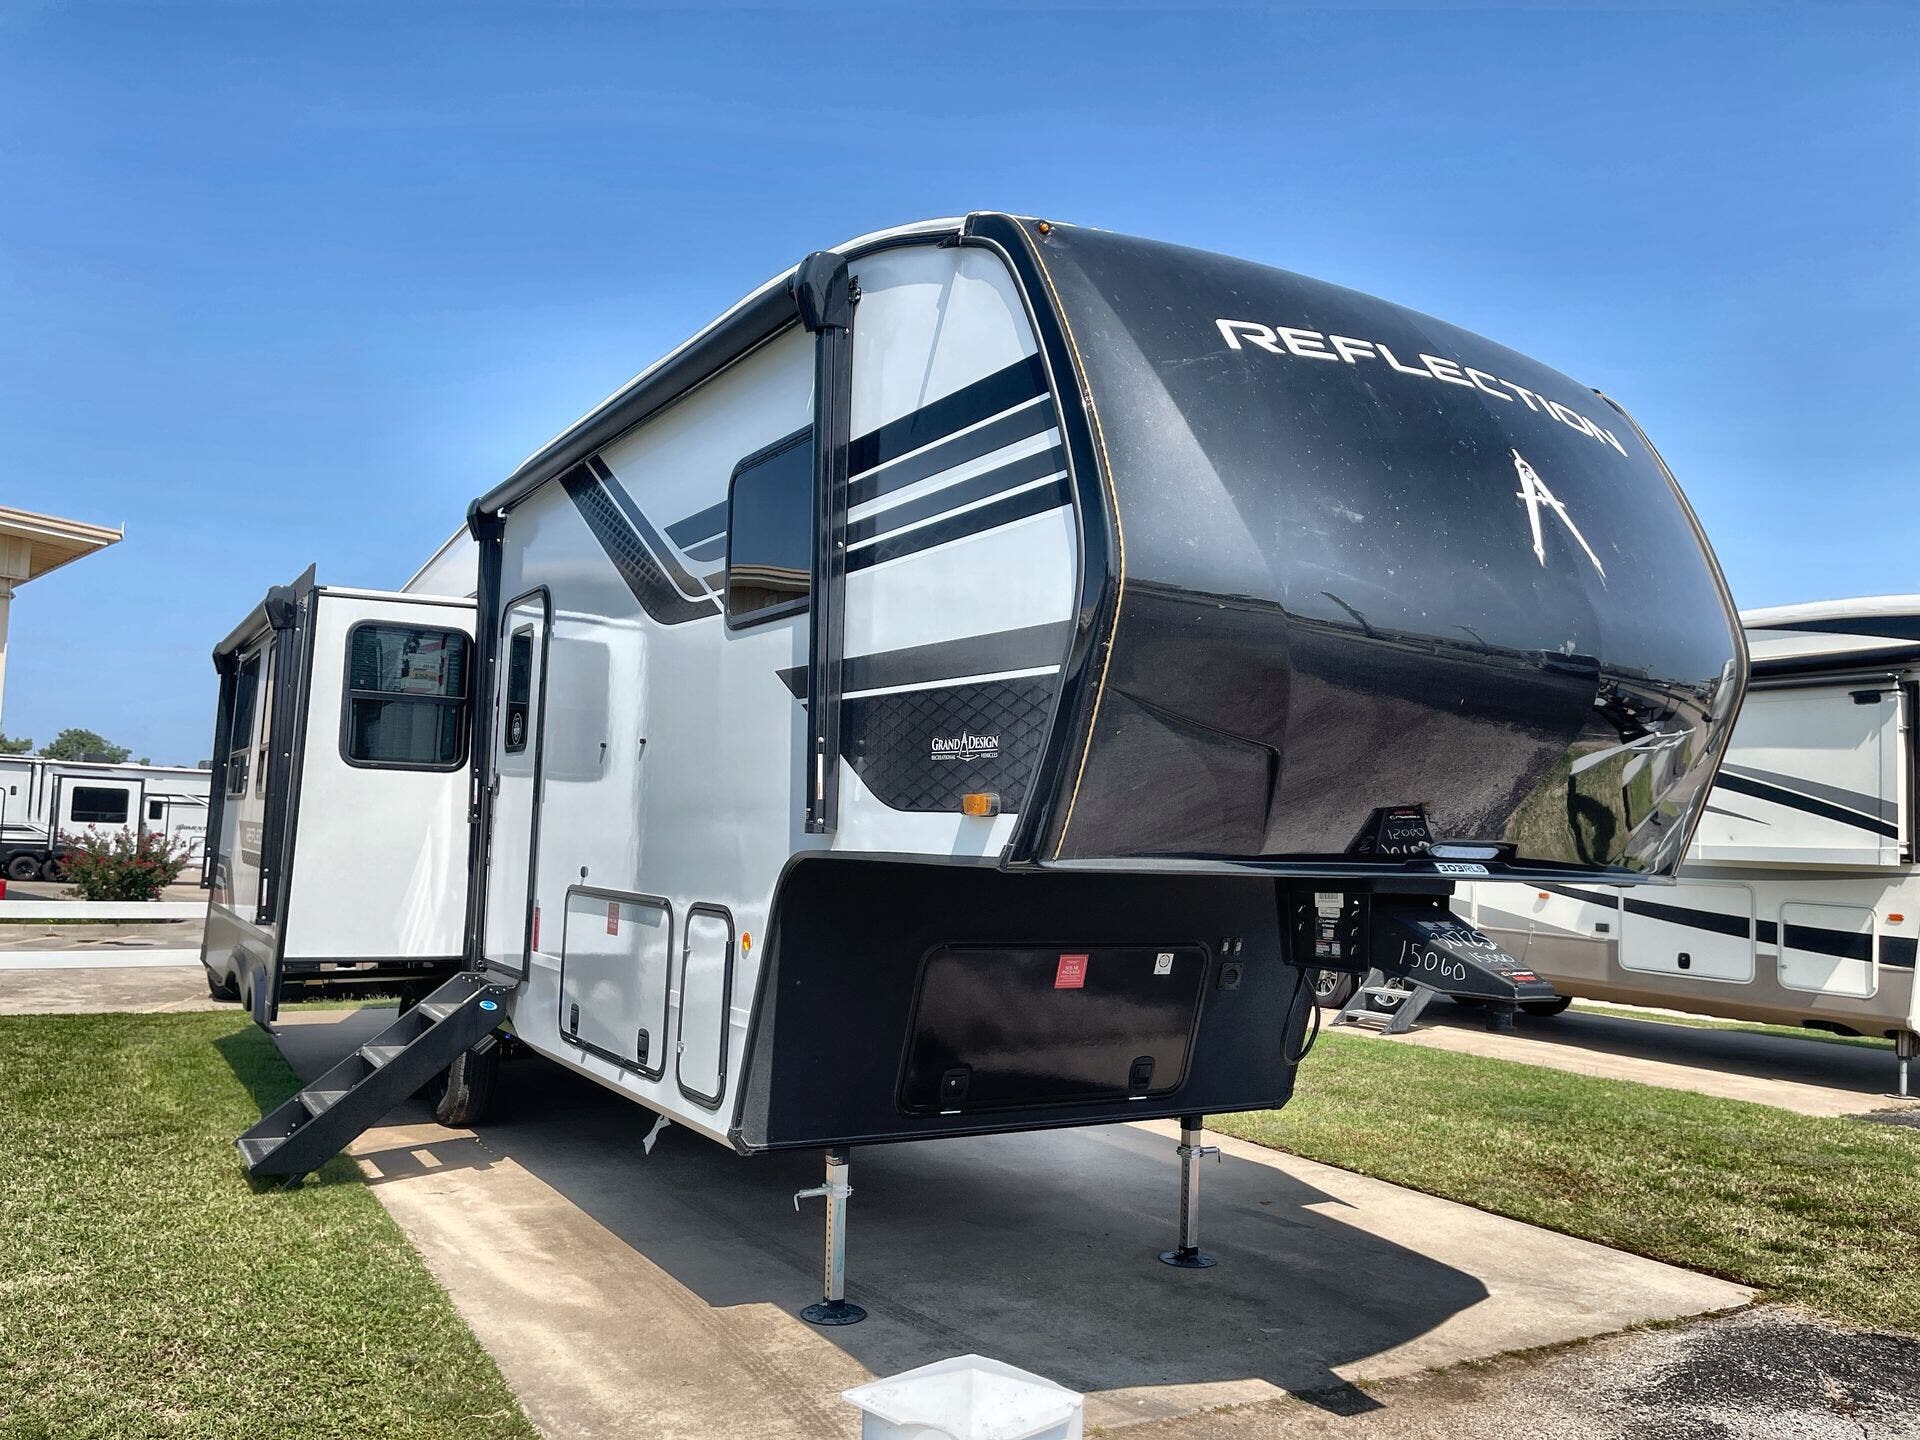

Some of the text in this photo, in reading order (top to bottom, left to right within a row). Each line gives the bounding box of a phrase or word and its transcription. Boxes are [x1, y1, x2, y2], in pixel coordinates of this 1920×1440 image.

[1215, 318, 1629, 458] REFLECTION
[931, 735, 999, 751] GRAND DESIGN
[1439, 864, 1486, 873] 303RLS
[1399, 940, 1466, 981] 15060
